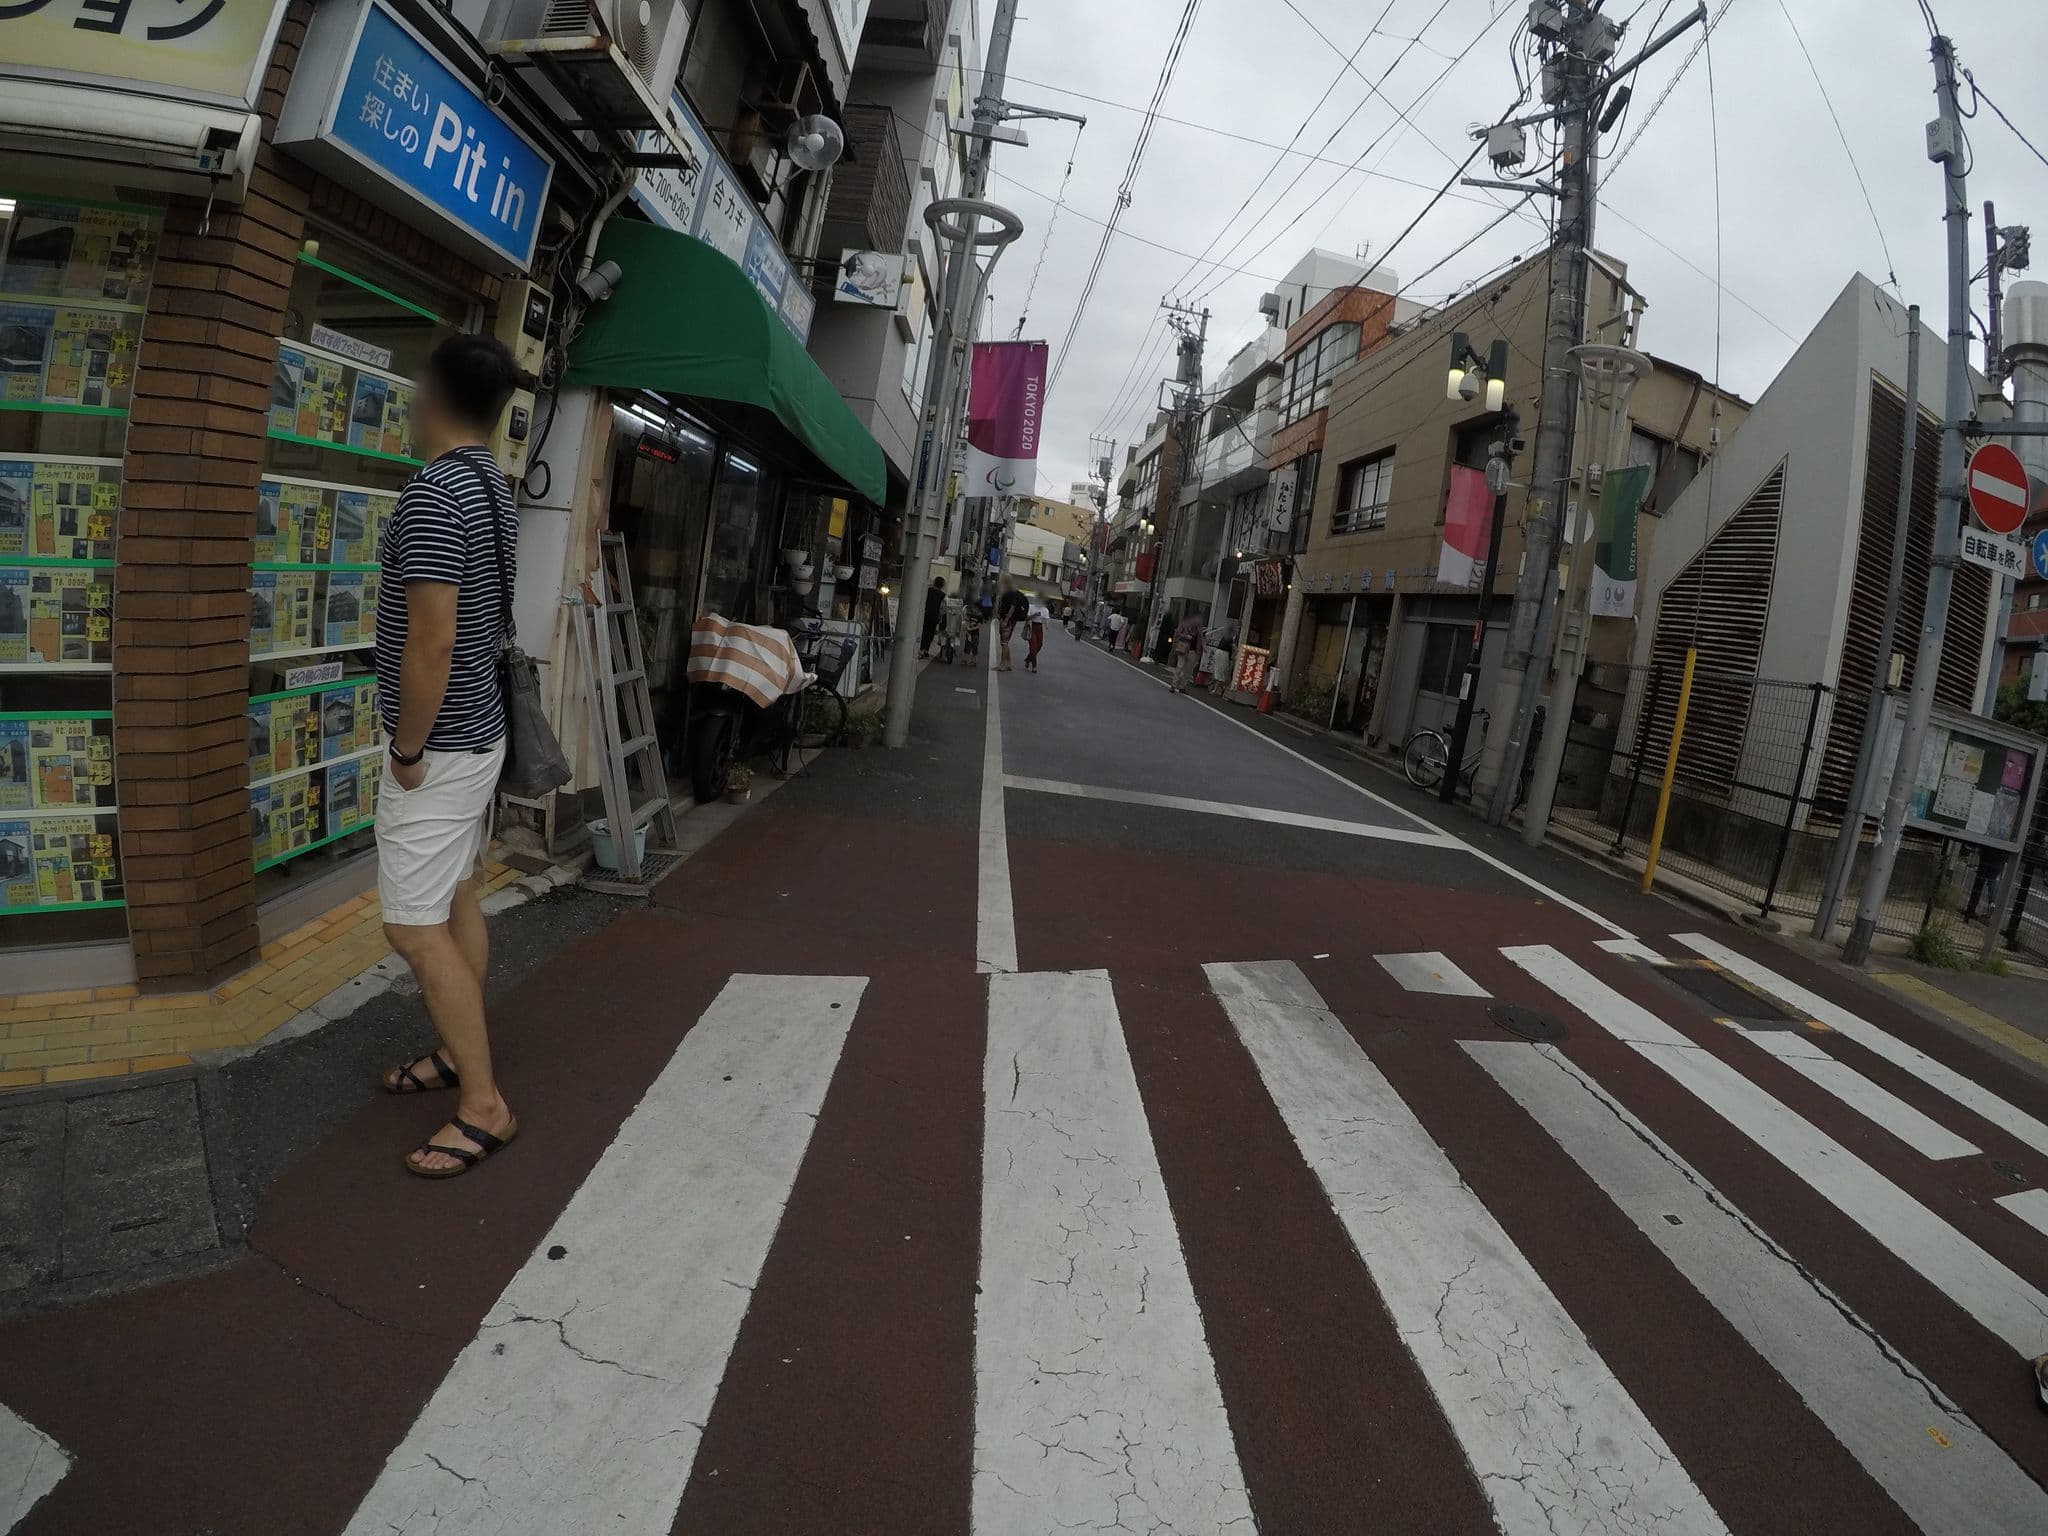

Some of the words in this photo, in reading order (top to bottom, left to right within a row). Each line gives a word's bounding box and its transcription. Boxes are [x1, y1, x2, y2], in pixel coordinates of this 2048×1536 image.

[373, 53, 430, 116] 住まい
[358, 91, 420, 155] 探しの
[423, 101, 487, 203] Pit
[491, 156, 527, 233] in
[655, 172, 691, 226] 700-6262
[712, 178, 747, 232] 合カギ
[1024, 375, 1039, 417] TOKYO
[1020, 418, 1035, 451] 2020
[1964, 534, 2023, 573] 自転車を除く
